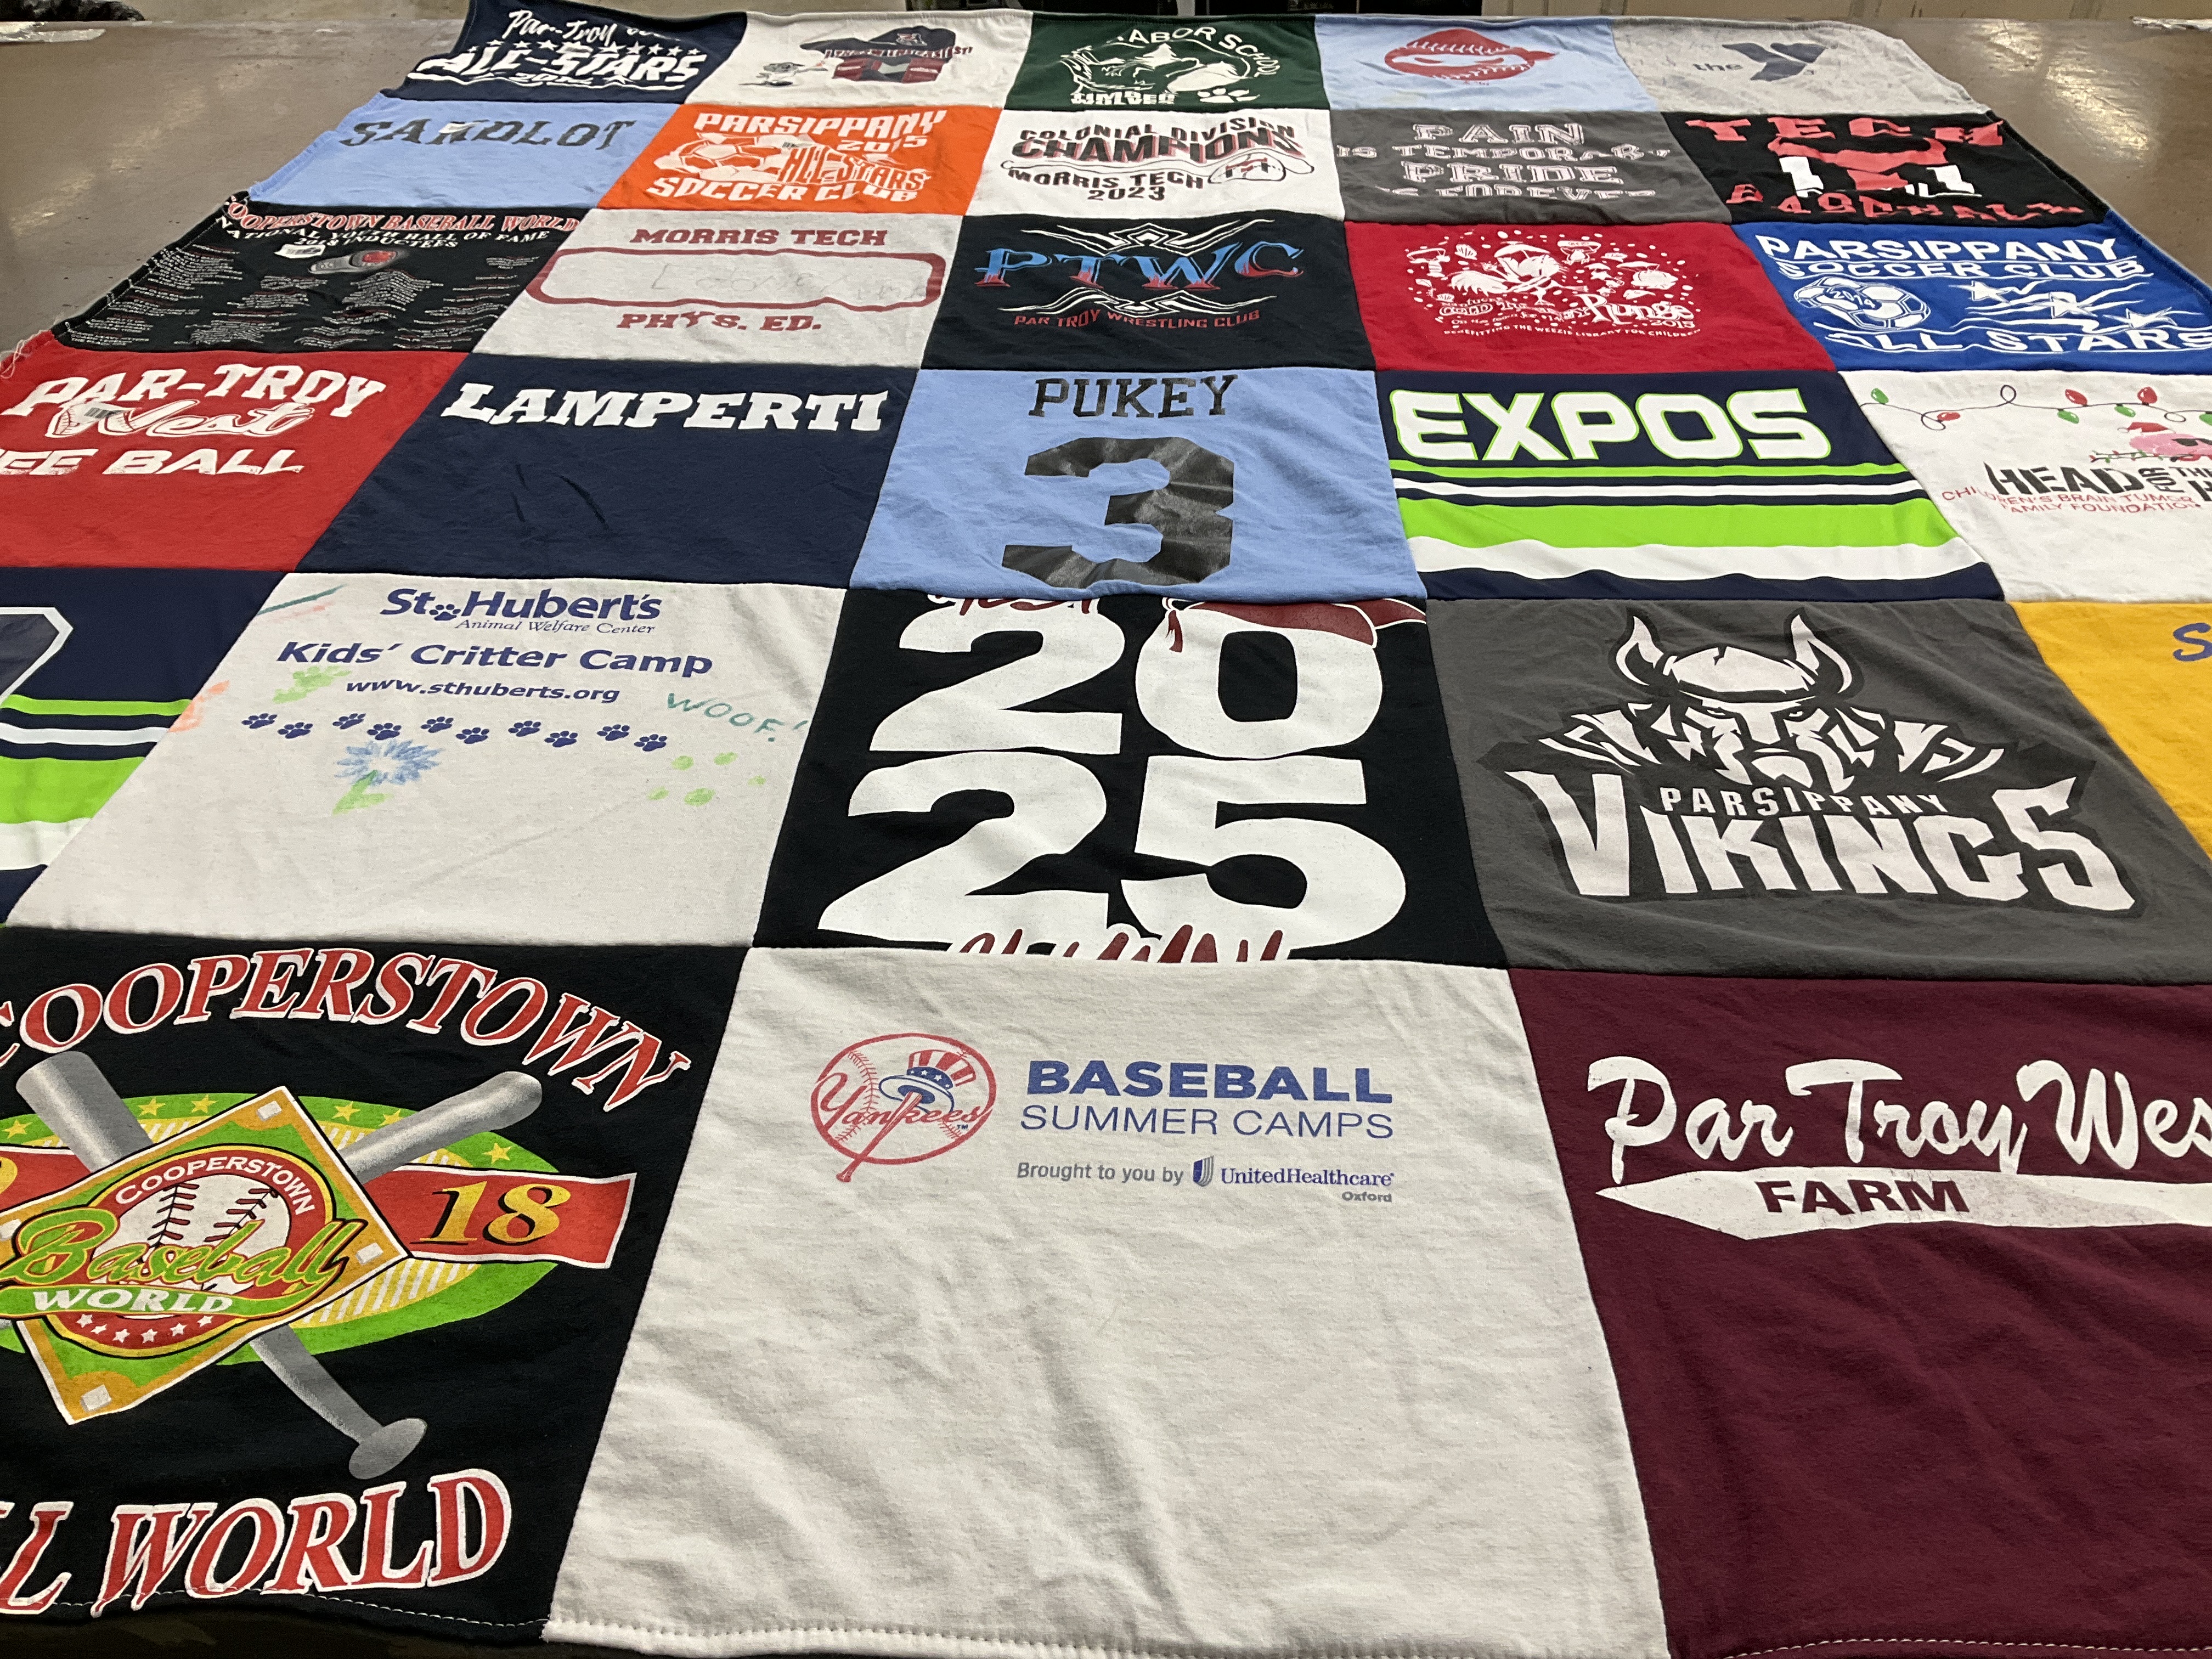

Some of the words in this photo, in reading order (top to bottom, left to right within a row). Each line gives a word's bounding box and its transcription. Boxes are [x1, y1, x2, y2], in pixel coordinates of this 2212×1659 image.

[501, 9, 618, 47] Par-Troy
[1114, 27, 1217, 43] ABOR
[1695, 60, 1743, 71] the
[338, 119, 637, 150] SANDLOT
[693, 110, 948, 136] PARSIPPANY
[1019, 123, 1160, 142] COLONIAL
[1170, 116, 1296, 143] DIVISION
[1412, 122, 1584, 146] PAIN
[1685, 117, 2004, 146] TECH
[837, 137, 928, 153] 2015
[1011, 127, 1307, 163] CHAMPIONS
[1336, 144, 1378, 159] IS
[1008, 168, 1120, 188] MORRIS
[1130, 171, 1204, 189] TECH
[1400, 161, 1624, 185] PRIDE
[646, 177, 810, 201] SOCCER
[814, 183, 917, 202] CLUB
[1087, 186, 1166, 201] 2023
[216, 216, 320, 239] NATIONAL
[331, 229, 399, 240] YOUTH
[405, 232, 458, 241] HALL
[463, 232, 492, 240] OF
[495, 230, 550, 242] FAME
[226, 201, 386, 231] OOPERSTOWN
[381, 214, 495, 231] BASEBALL
[500, 215, 580, 232] WORLD
[343, 235, 459, 248] INDUCTEES
[630, 228, 780, 245] MORRIS
[790, 229, 888, 247] TECH
[1756, 234, 2117, 262] PARSIPPANY
[974, 240, 1305, 291] PTWC
[1779, 261, 1981, 279] SOCCER
[1993, 259, 2145, 278] CLUB
[616, 311, 747, 330] PHYS.
[759, 315, 822, 330] ED.
[1013, 315, 1051, 328] PAR
[1056, 308, 1101, 329] TROY
[1107, 311, 1208, 329] WRESTLING
[1214, 308, 1261, 328] CLUB
[1988, 329, 2212, 351] STARS
[0, 363, 386, 418] PAR-TROY
[1028, 374, 1238, 419] PUKEY
[45, 399, 316, 438] West
[441, 382, 889, 432] LAMPERTI
[1389, 387, 1832, 461] EXPOS
[0, 449, 99, 475] EE
[102, 448, 304, 475] BALL
[1983, 462, 2145, 495] HEAD
[2138, 467, 2185, 493] FOR
[1002, 437, 1235, 589] 3
[2057, 493, 2114, 503] BRAIN
[2122, 493, 2196, 504] TUMOR
[460, 588, 662, 621] Hubert's
[455, 618, 522, 631] Animal
[528, 619, 591, 633] Welfare
[596, 622, 656, 634] Center
[276, 641, 404, 664] Kids'
[410, 645, 567, 669] Critter
[579, 649, 713, 678] Camp
[346, 679, 621, 703] www.sthuberts.org
[1659, 786, 1948, 816] PARSIPPANY
[817, 751, 1407, 951] 25
[1505, 769, 2136, 911] VIKINGS
[1026, 1060, 1393, 1104] BASEBALL
[816, 1073, 994, 1134] Yankees
[1020, 1105, 1218, 1135] SUMMER
[1233, 1109, 1394, 1139] CAMPS
[1587, 1055, 1794, 1184] Par
[1784, 1058, 2029, 1175] Troy
[115, 1155, 315, 1216] COOPERSTOWN
[1017, 1161, 1092, 1182] Brought
[1097, 1164, 1116, 1180] to
[1121, 1166, 1155, 1183] you
[1162, 1166, 1184, 1187] by
[1341, 1191, 1392, 1203] Oxford
[1753, 1177, 1971, 1215] FARM
[418, 1180, 573, 1247] 18
[0, 1205, 370, 1292] Baseball
[32, 1287, 235, 1314] WORLD
[90, 1468, 513, 1619] WORLD
